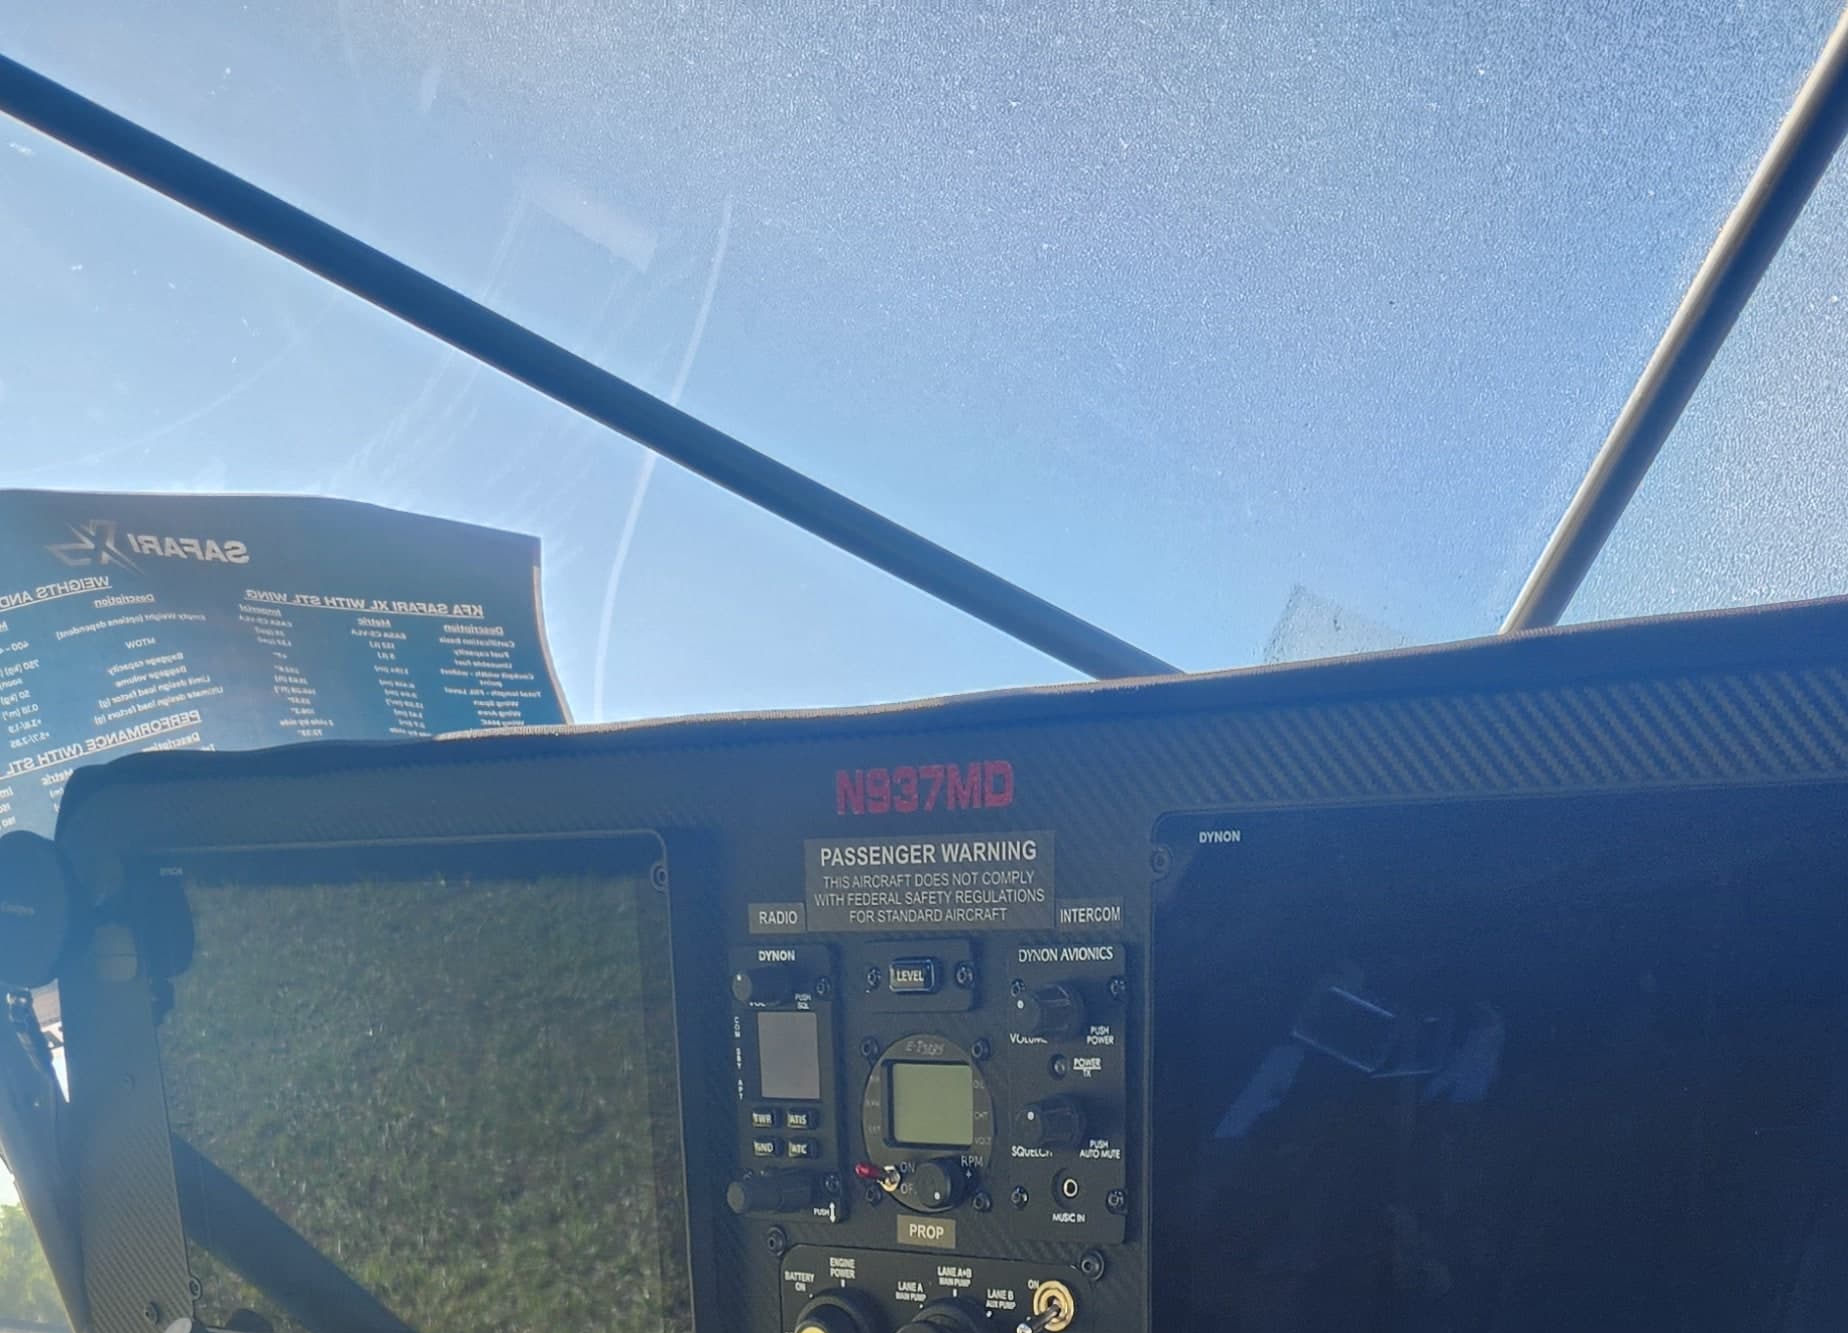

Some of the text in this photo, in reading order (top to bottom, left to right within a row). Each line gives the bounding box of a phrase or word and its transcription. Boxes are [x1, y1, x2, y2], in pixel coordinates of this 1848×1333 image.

[835, 760, 1014, 816] N937MD
[1199, 830, 1241, 843] DYNON
[820, 840, 1037, 867] PASSENGER WARNING
[824, 870, 1034, 889] THIS AIRCRAFT DOES NOT COMPLY
[814, 888, 1045, 907] WITH FEDERAL SAFETY REGULATIONS
[759, 910, 798, 925] RADIO
[849, 907, 1007, 923] FOR STANDARD AIRCRAFT
[1060, 906, 1120, 923] INTERCOM
[758, 949, 796, 961] DYNON
[1018, 946, 1113, 962] DYNON AVIONICS
[896, 969, 924, 982] LEVEL
[1090, 1026, 1109, 1036] PUSH
[1087, 1035, 1114, 1045] POWER
[1073, 1058, 1101, 1067] POWER
[1090, 1139, 1109, 1149] PUSH
[1080, 1149, 1121, 1159] AUTO MUTE
[900, 1162, 916, 1173] ON
[961, 1155, 984, 1168] RPM
[814, 1208, 830, 1216] PUSH
[1052, 1213, 1086, 1223] MUSIC IN
[909, 1224, 944, 1239] PROP
[830, 1257, 855, 1269] ENGINE
[784, 1270, 815, 1283] BATTERY
[830, 1268, 855, 1279] POWER
[937, 1266, 957, 1277] LANE
[795, 1282, 806, 1292] ON
[898, 1281, 924, 1293] LANE A
[954, 1278, 971, 1288] PUMP
[1028, 1279, 1039, 1290] ON
[911, 1292, 927, 1302] PUMP
[987, 1288, 1014, 1300] LANE B
[1000, 1300, 1016, 1310] PUMP
